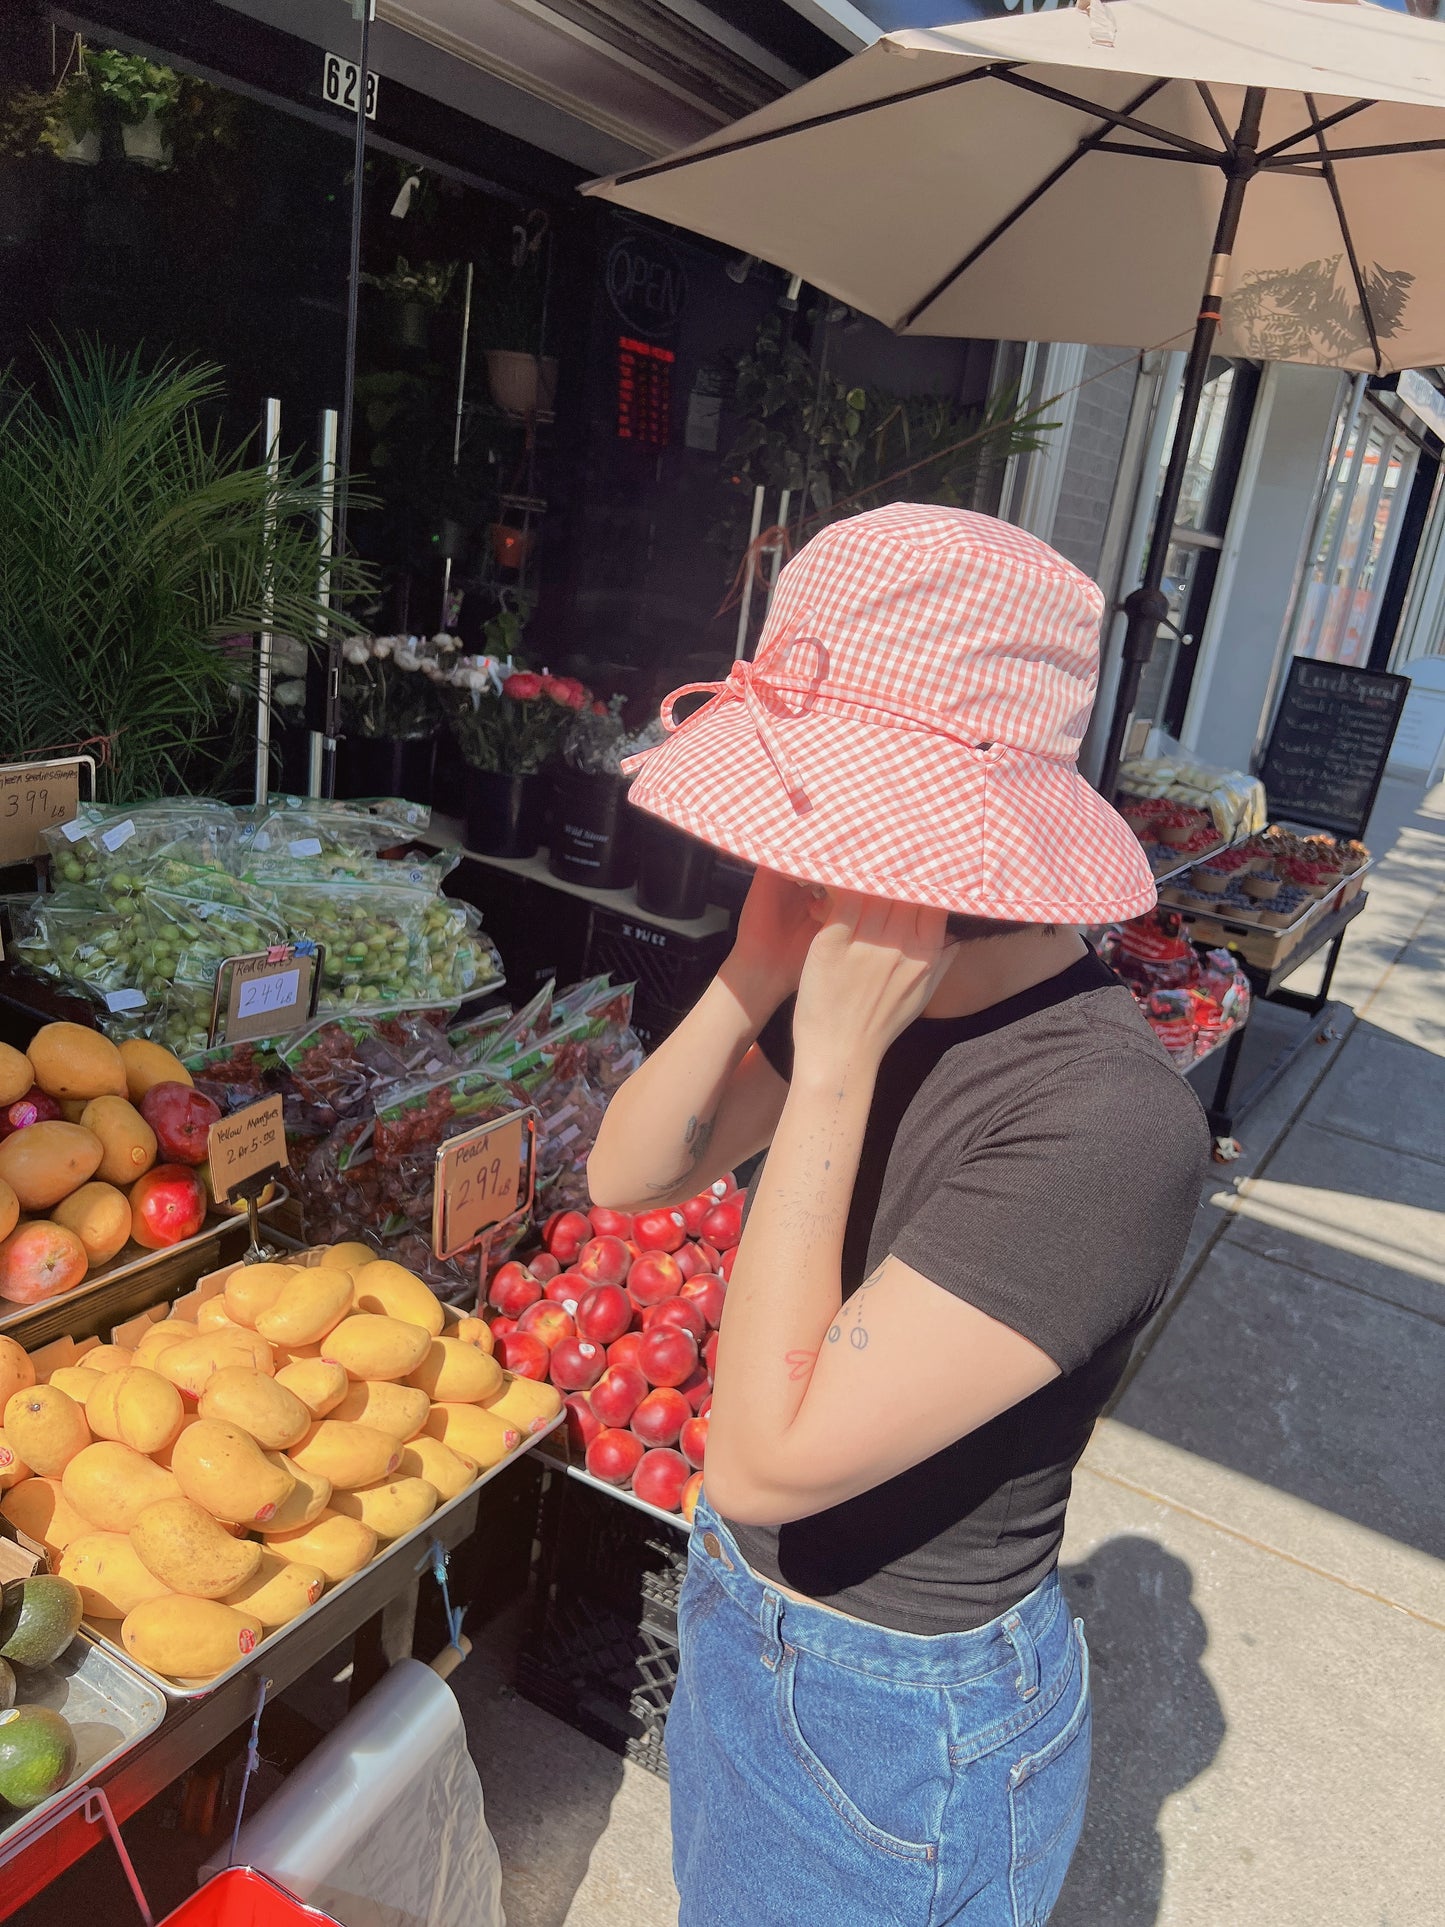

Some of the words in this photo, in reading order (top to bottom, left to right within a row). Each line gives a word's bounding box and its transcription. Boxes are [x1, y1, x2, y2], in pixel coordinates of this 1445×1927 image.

[326, 57, 375, 115] 628
[612, 249, 681, 317] OPEN
[236, 959, 256, 977] Red
[217, 1126, 243, 1144] Yellow
[227, 1149, 237, 1165] 2
[250, 1129, 276, 1153] 5.00
[455, 1135, 489, 1168] Peach
